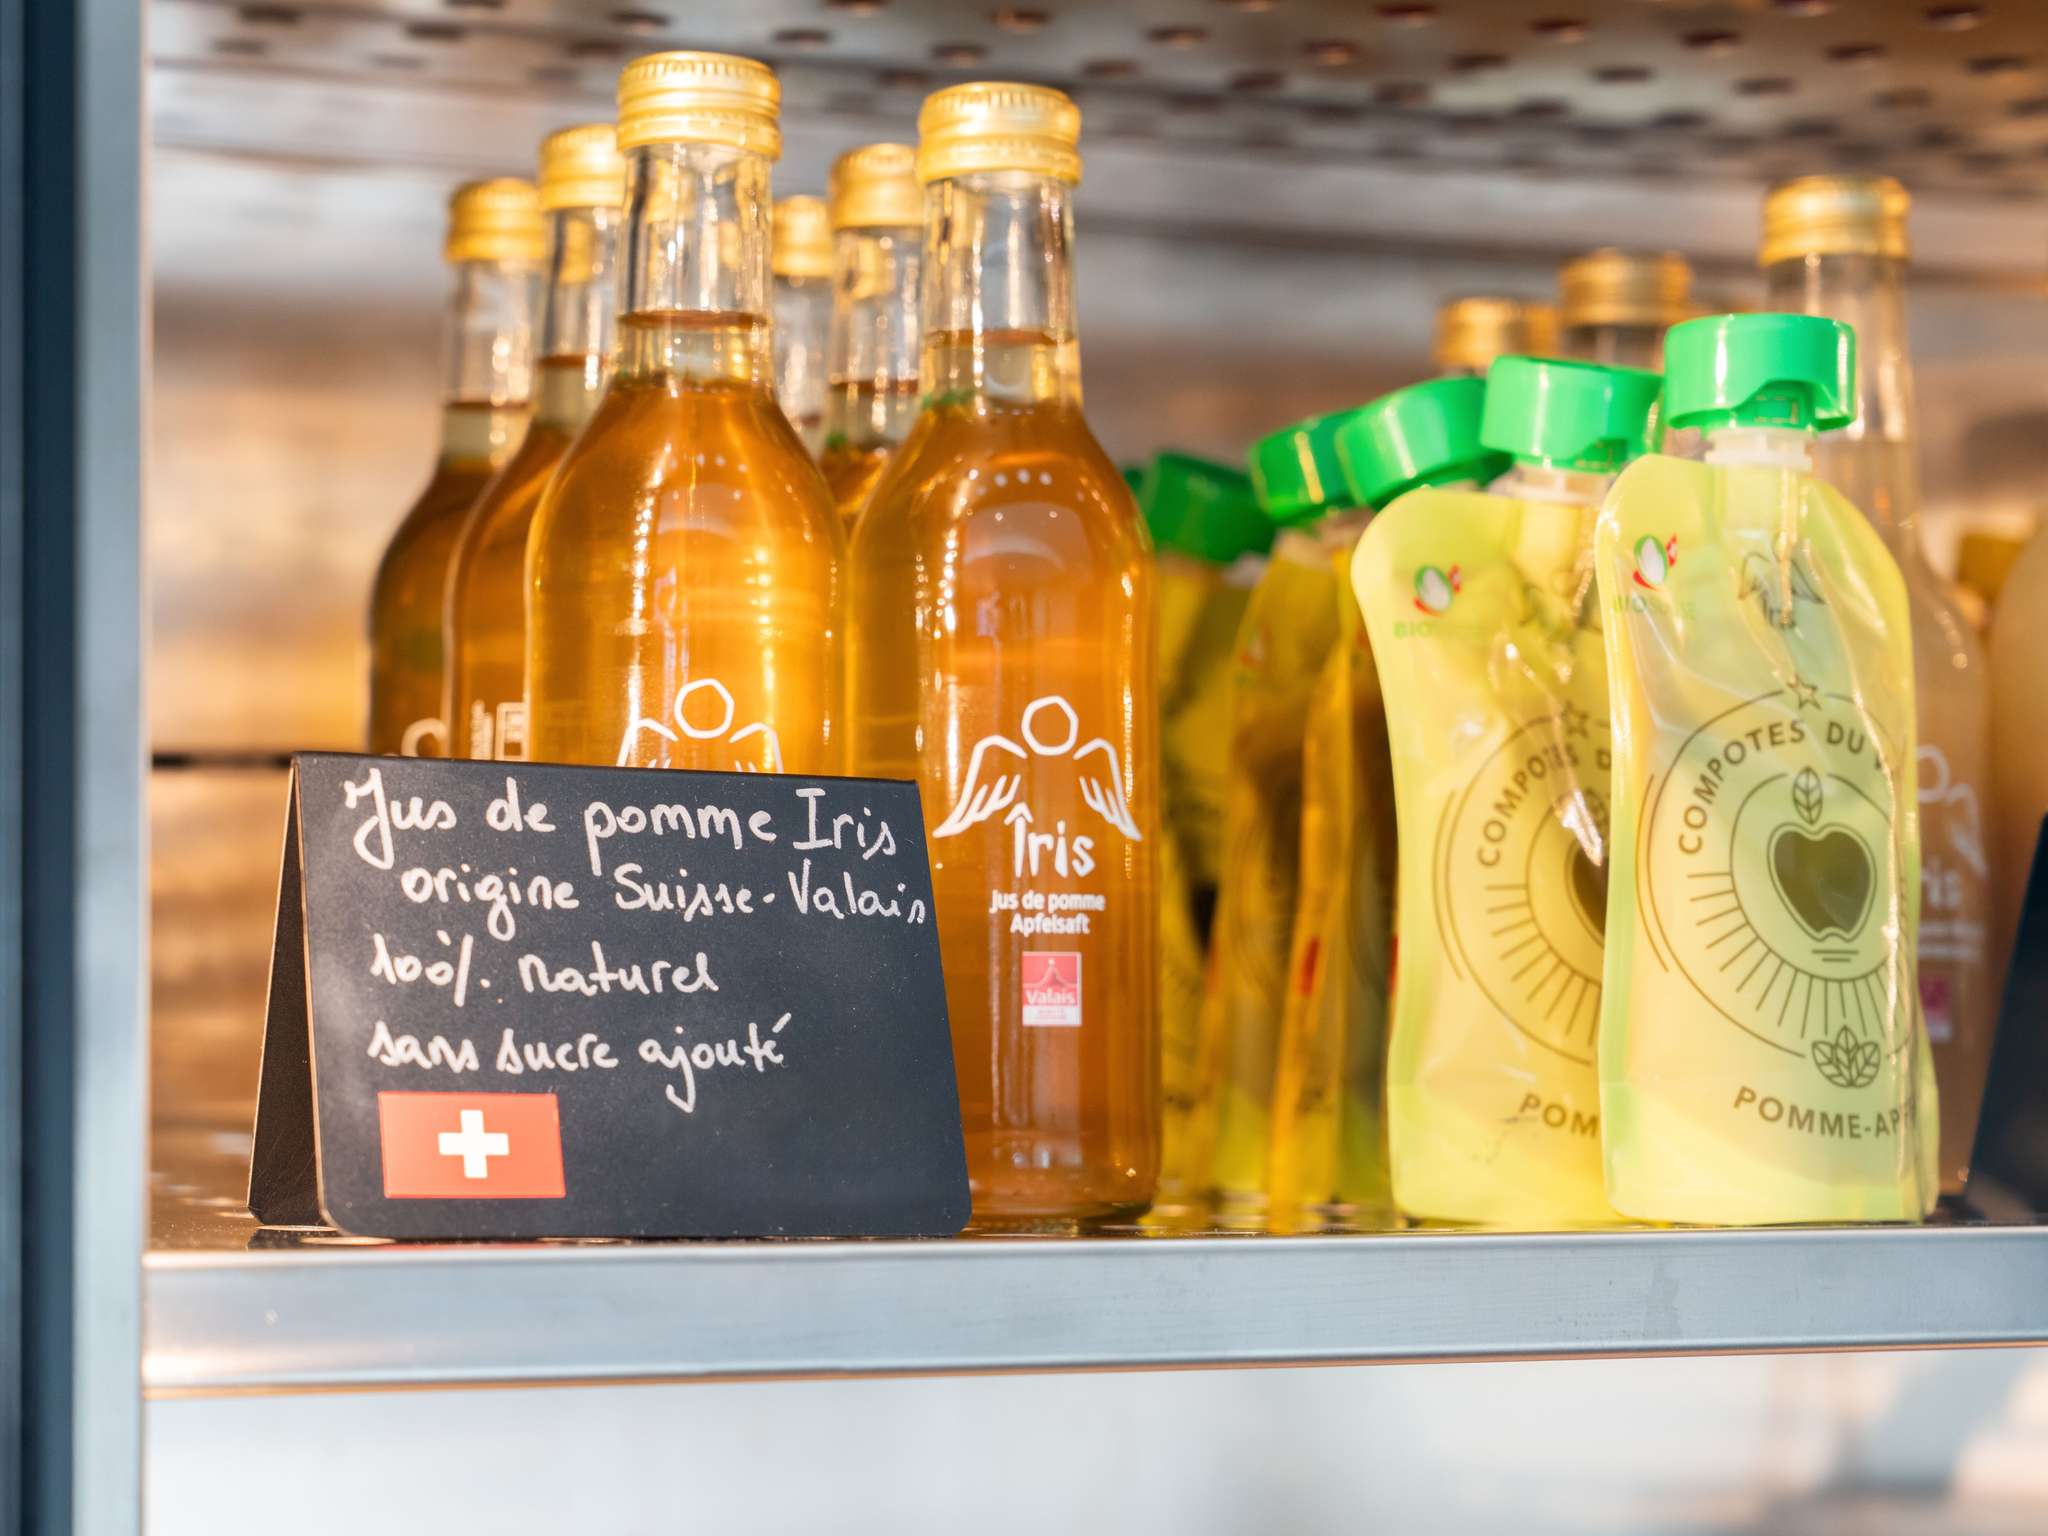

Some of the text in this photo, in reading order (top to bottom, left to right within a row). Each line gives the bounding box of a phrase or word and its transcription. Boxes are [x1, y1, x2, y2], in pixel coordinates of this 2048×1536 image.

[1678, 719, 1865, 855] COMPOTES DU
[344, 768, 897, 876] Jus de pomme Iris
[1003, 802, 1096, 878] Îris
[400, 862, 580, 941] origine
[1009, 912, 1091, 938] Apfelsaft
[1022, 889, 1045, 910] de
[1047, 893, 1105, 914] pomme
[518, 940, 720, 998] naturel
[1024, 987, 1076, 1006] Valais
[367, 1012, 793, 1114] sans sucre ajouté
[1518, 1091, 1599, 1140] POM
[1733, 1085, 1908, 1140] POMME-AP
